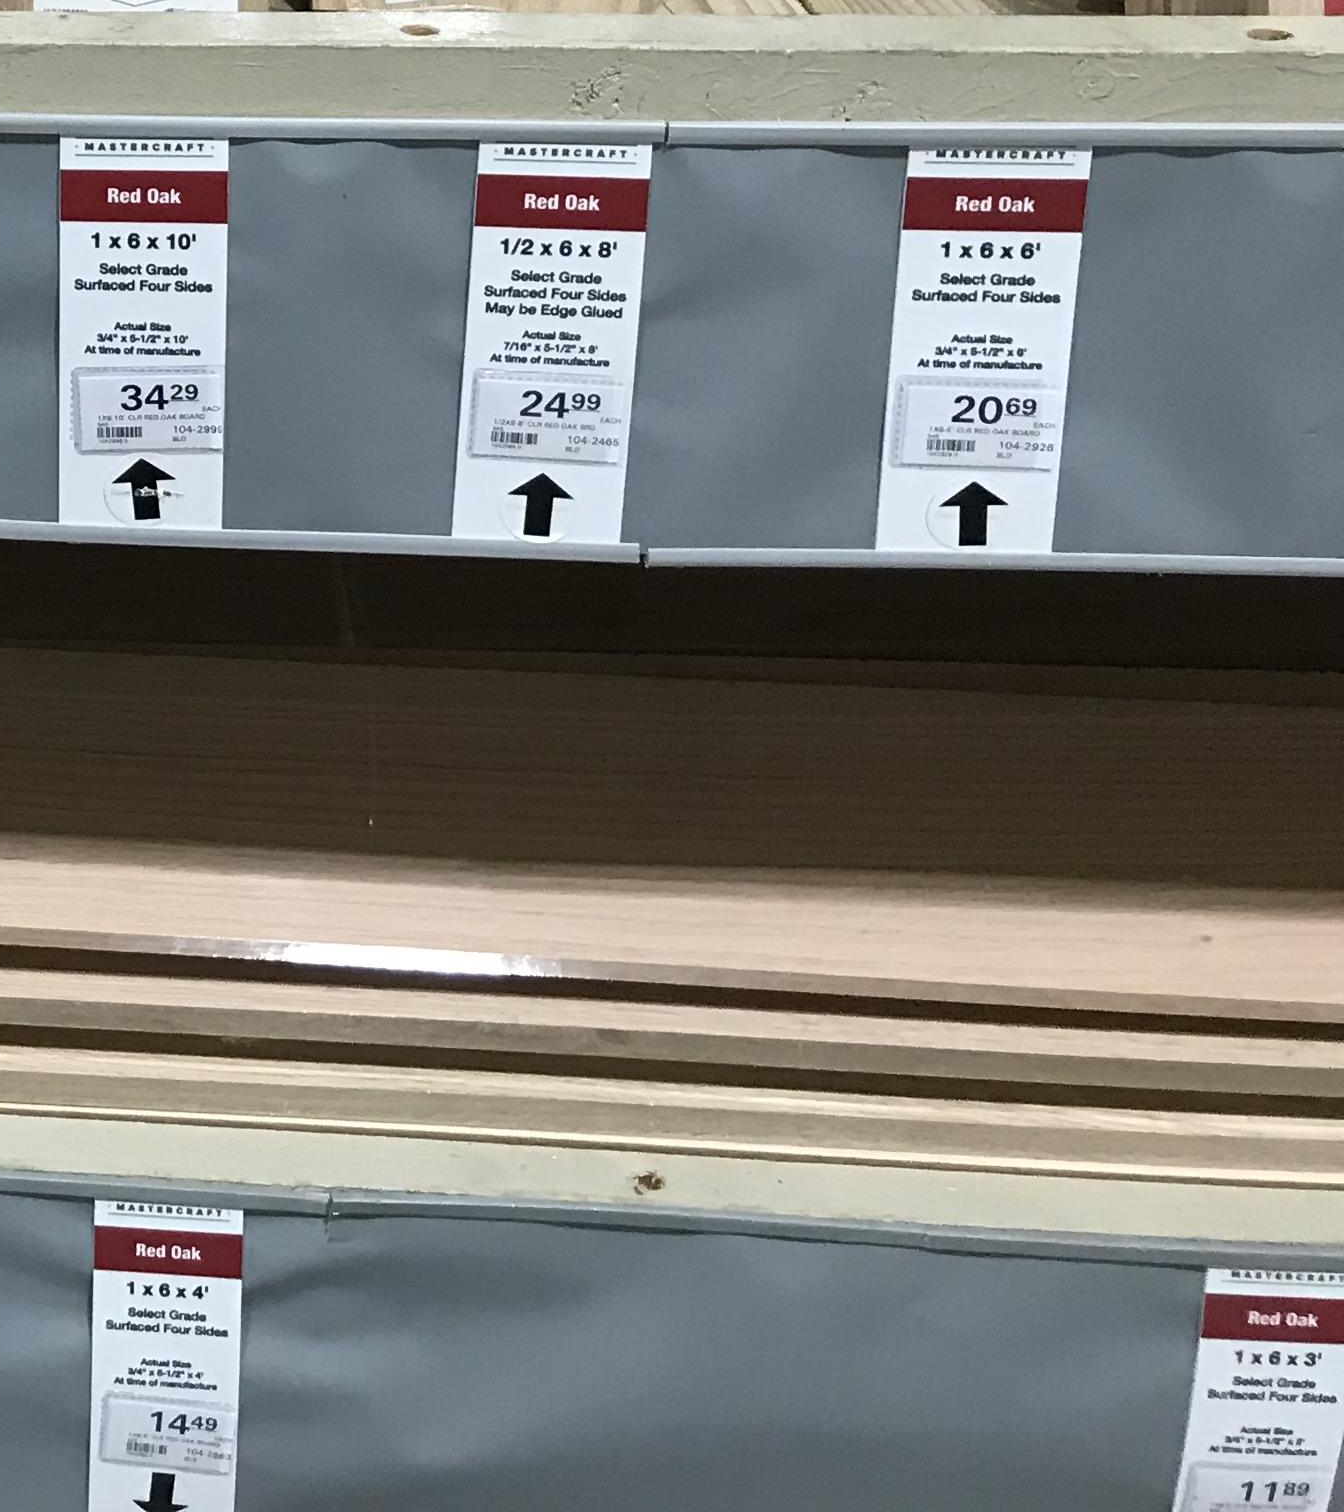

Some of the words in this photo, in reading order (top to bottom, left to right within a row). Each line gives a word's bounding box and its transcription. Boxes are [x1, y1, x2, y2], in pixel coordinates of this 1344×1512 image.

[107, 189, 141, 204] Red
[147, 189, 181, 205] Oak
[524, 194, 559, 210] Red
[565, 195, 600, 212] Oak
[955, 197, 993, 212] Red
[998, 197, 1035, 213] Oak
[485, 303, 515, 317] May
[519, 304, 537, 316] be
[540, 304, 577, 319] Edge
[581, 304, 623, 319] Glued
[136, 1243, 165, 1258] Red
[171, 1245, 201, 1260] Oak
[1248, 1310, 1280, 1326] Red
[1285, 1313, 1318, 1328] Oak
